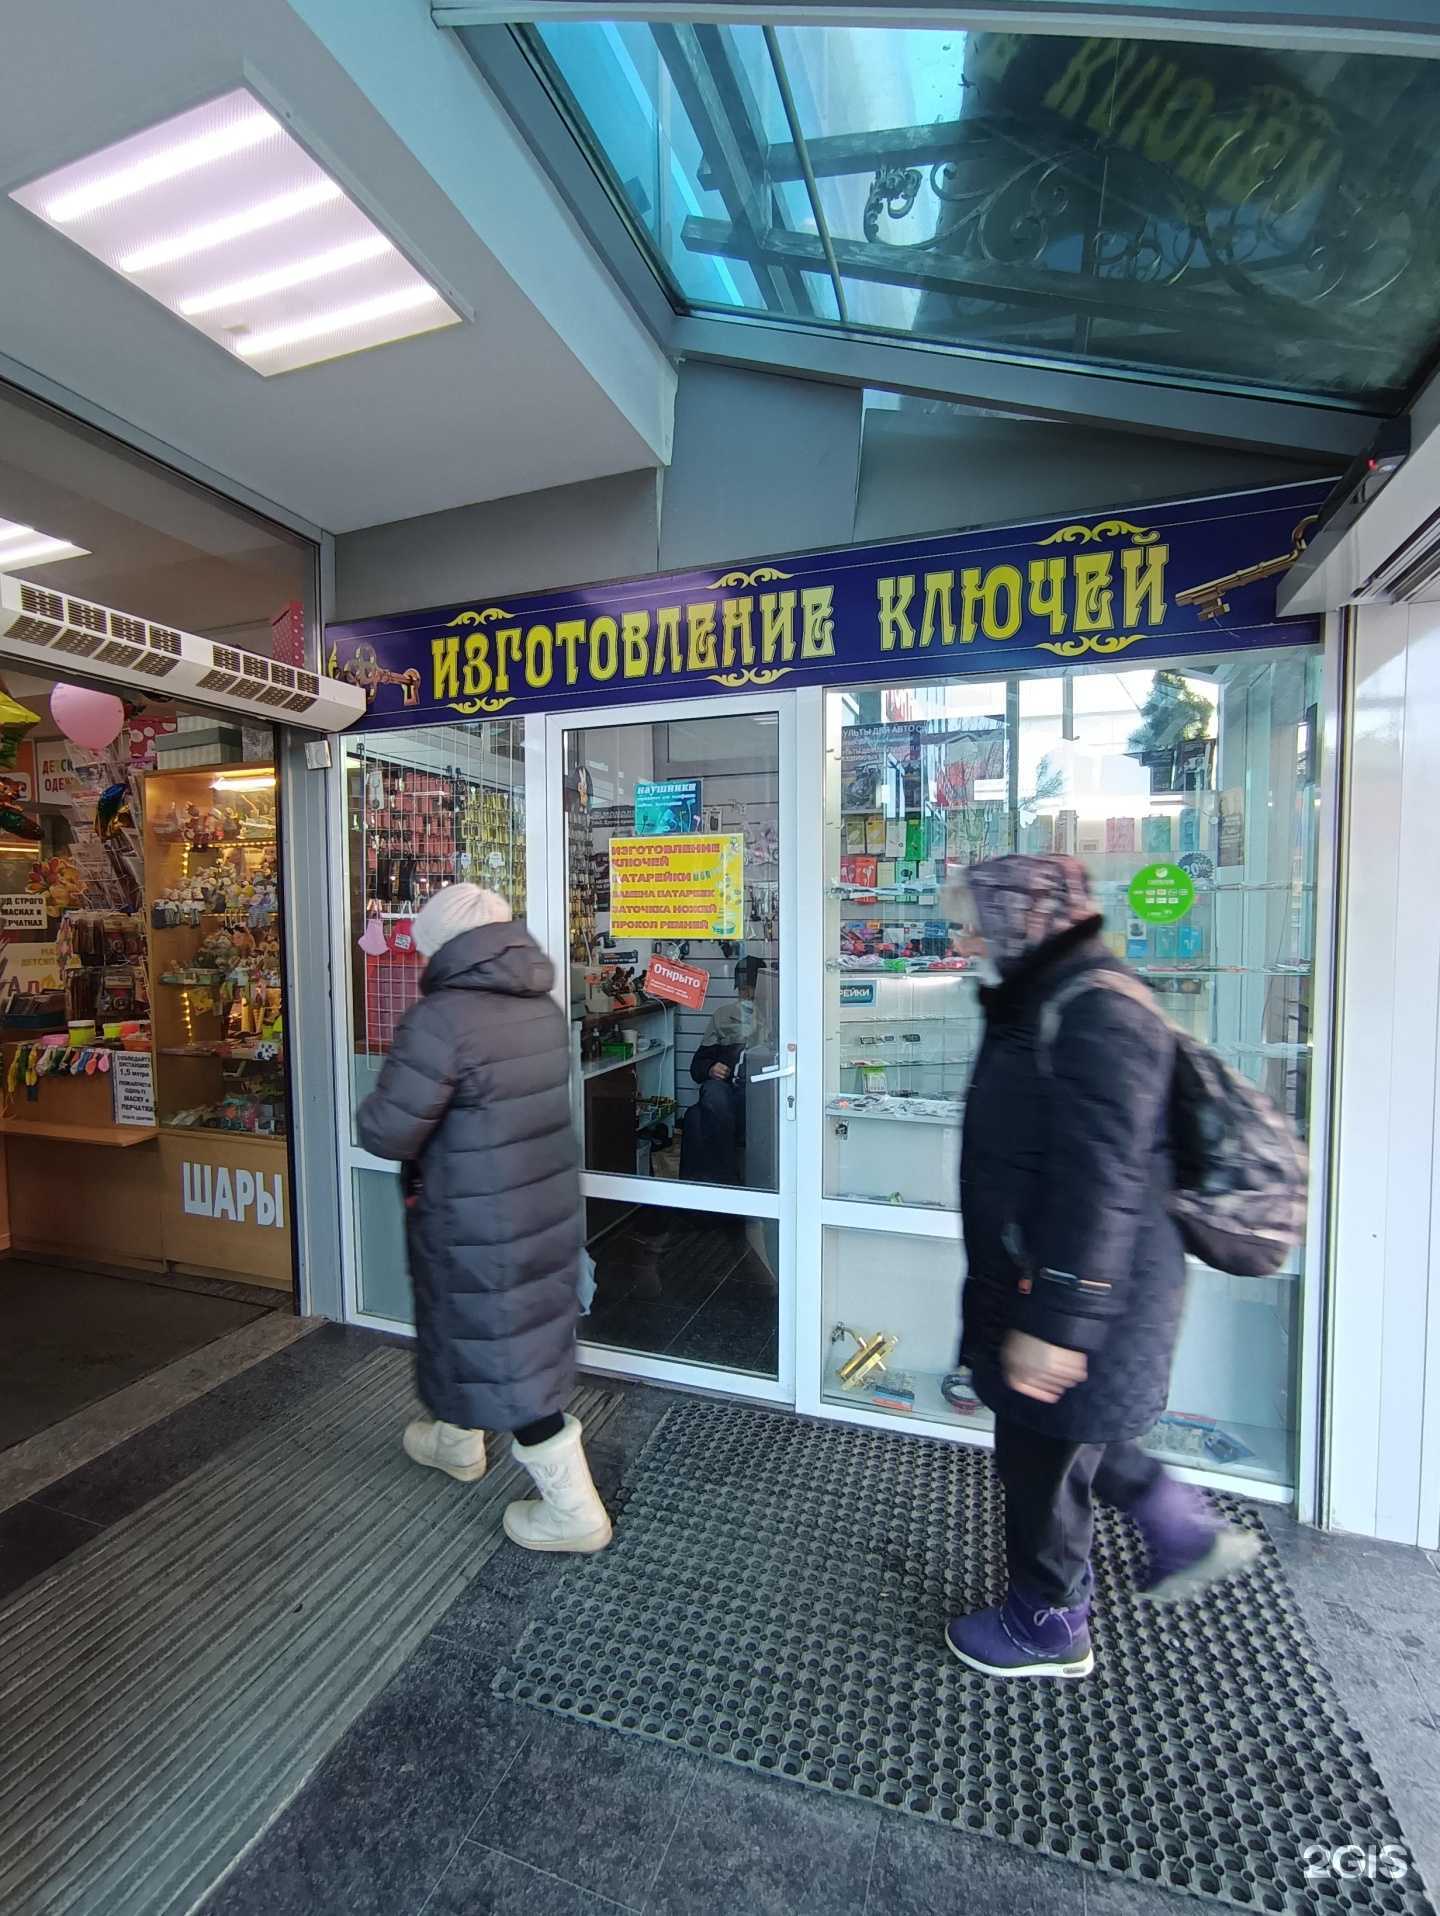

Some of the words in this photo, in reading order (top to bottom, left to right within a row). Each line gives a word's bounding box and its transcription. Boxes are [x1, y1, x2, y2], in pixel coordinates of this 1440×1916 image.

[431, 584, 836, 700] ИЗГОТОВЛЕНИЕ
[877, 530, 1170, 651] КЛЮЧЕЙ
[611, 843, 721, 856] ИЗГОТОВЛЕНИЕ
[611, 920, 658, 929] ПРОКОЛ
[654, 962, 701, 989] Открыто
[183, 1161, 284, 1228] ШАРЫ
